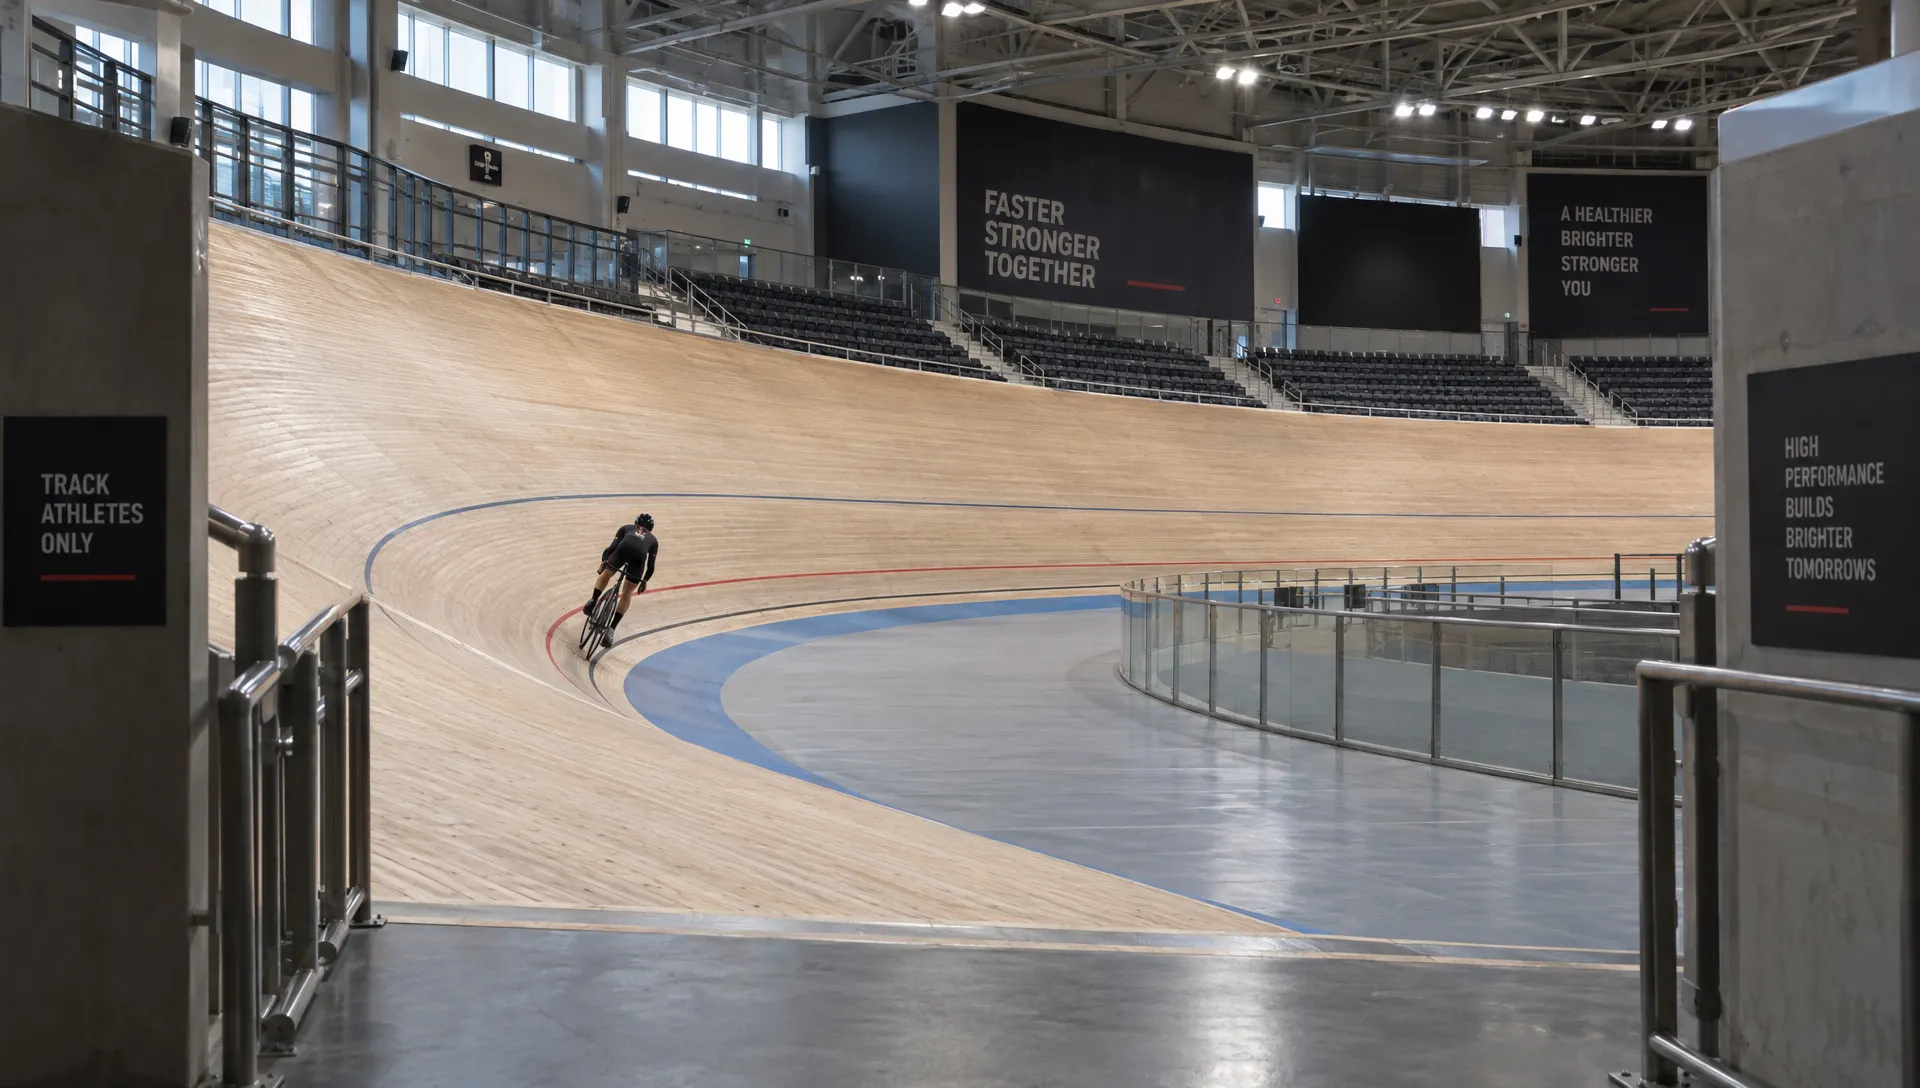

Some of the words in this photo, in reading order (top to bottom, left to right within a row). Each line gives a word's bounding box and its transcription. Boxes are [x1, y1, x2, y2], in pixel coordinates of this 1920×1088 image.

[985, 190, 1064, 225] FASTER
[1560, 206, 1571, 222] A
[1575, 206, 1653, 224] HEALTHIER
[985, 220, 1100, 260] STRONGER
[1561, 230, 1634, 248] BRIGHTER
[985, 250, 1095, 288] TOGETHER
[1561, 256, 1639, 273] STRONGER
[1561, 280, 1591, 297] YOU
[1784, 435, 1819, 459] HIGH
[41, 473, 110, 495] TRACK
[1784, 462, 1885, 488] PERFORMANCE
[41, 503, 144, 524] ATHLETES
[1785, 496, 1835, 519] BUILDS
[41, 532, 94, 554] ONLY
[1785, 527, 1853, 549] BRIGHTER
[1785, 557, 1877, 581] TOMORROWS
